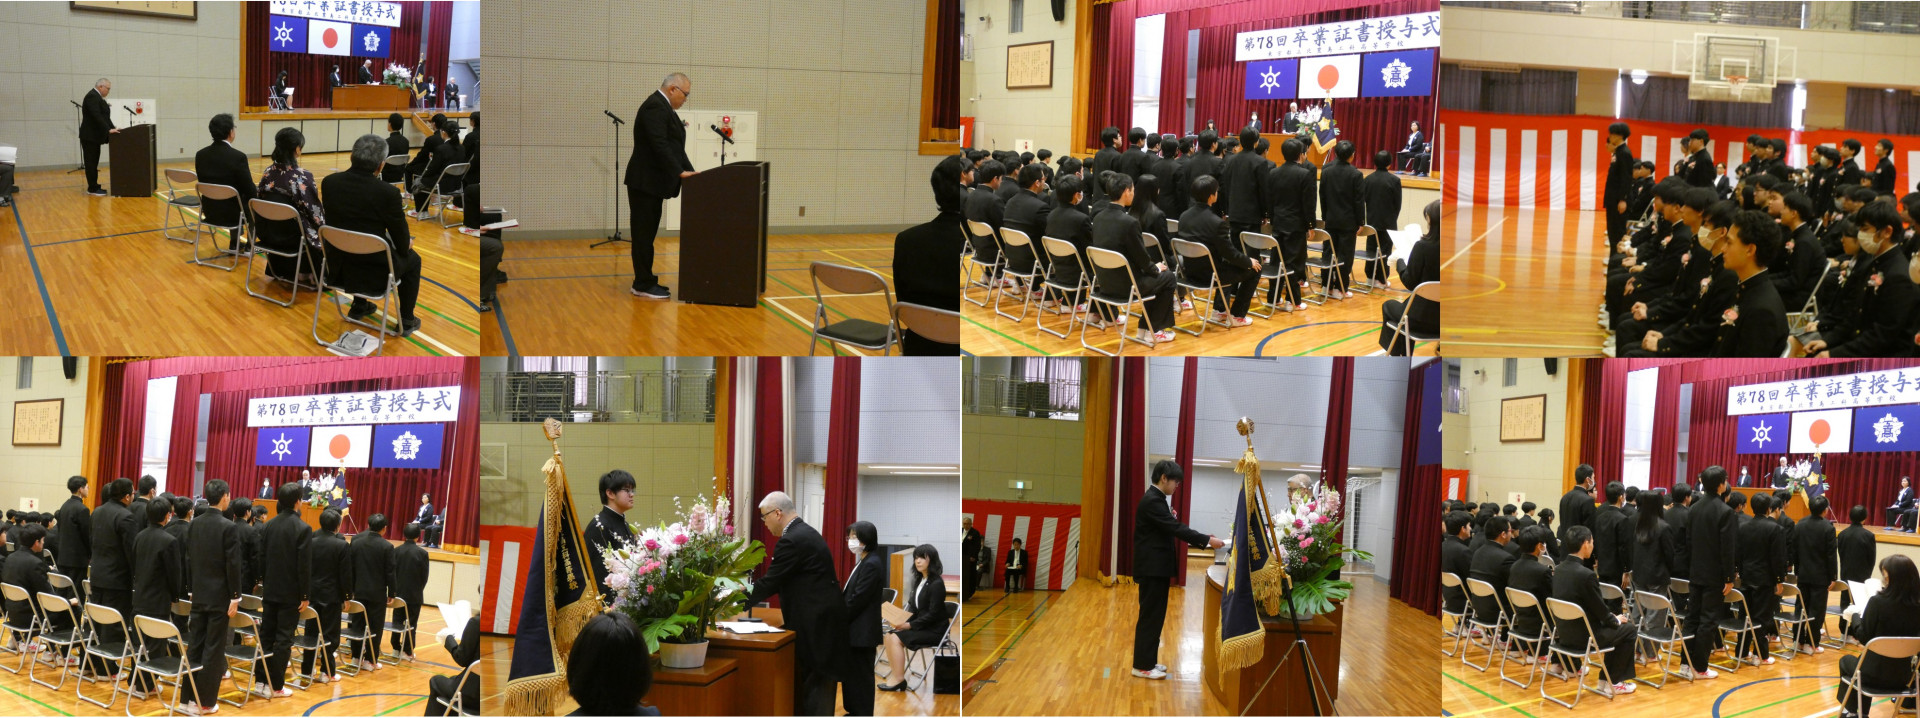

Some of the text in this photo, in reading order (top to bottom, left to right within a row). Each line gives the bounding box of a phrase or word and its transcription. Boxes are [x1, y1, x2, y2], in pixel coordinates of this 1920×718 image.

[257, 390, 452, 418] 第78回卒業証書授与式
[1736, 371, 1920, 406] 第78回卒業証書授与
